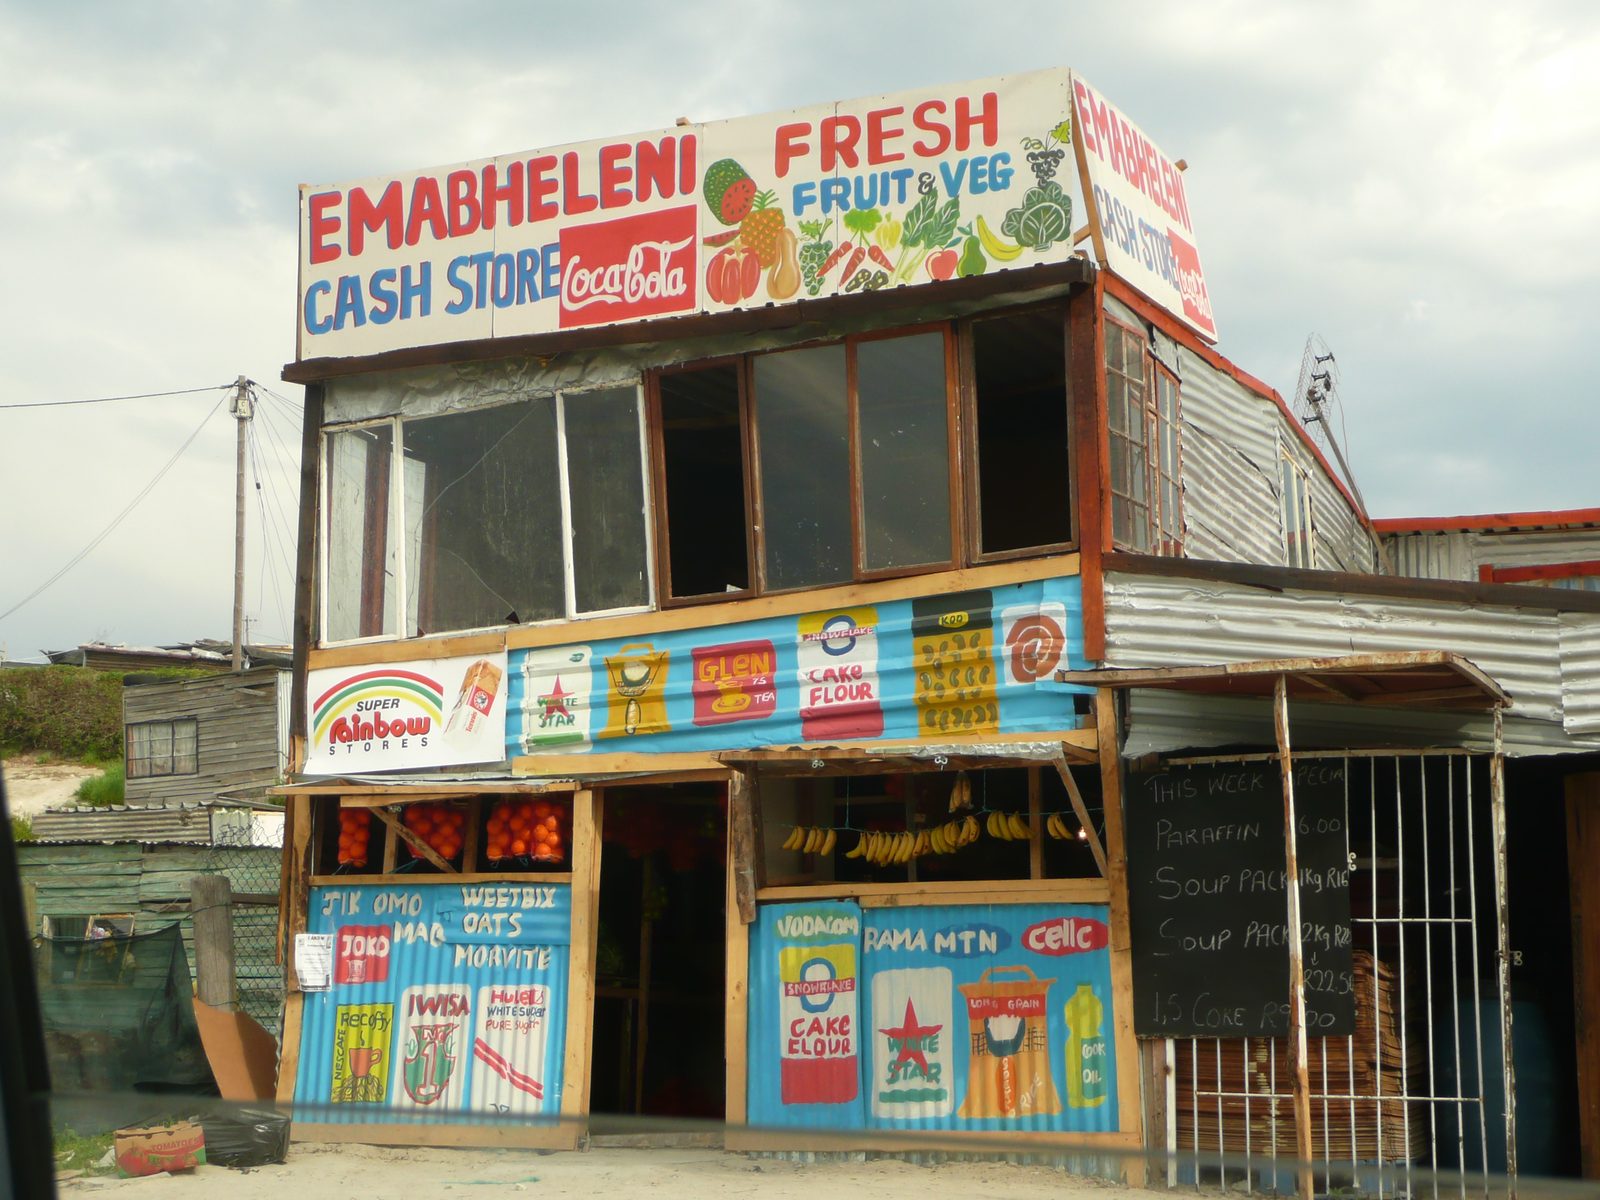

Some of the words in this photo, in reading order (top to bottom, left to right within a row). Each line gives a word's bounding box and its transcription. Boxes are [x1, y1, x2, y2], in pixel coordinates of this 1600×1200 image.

[775, 92, 998, 178] FRESH
[1074, 79, 1193, 234] EMABHELENI
[793, 168, 914, 216] FRUIT
[918, 171, 936, 195] &
[939, 152, 1015, 198] VEG
[309, 134, 697, 265] EMABHELENI
[1094, 184, 1141, 263] CASH
[1138, 217, 1181, 292] STORE
[304, 261, 431, 335] CASH
[445, 242, 560, 315] STORE
[804, 626, 874, 641] SNOWFLAKE
[356, 698, 400, 712] SUPER
[754, 692, 775, 704] TEA
[810, 682, 874, 706] FLOUR
[539, 713, 575, 728] STAR
[329, 737, 428, 756] STORES
[1144, 773, 1198, 804] THIS
[1208, 772, 1265, 796] WEEK
[1156, 818, 1261, 852] PARAFFIN
[1156, 866, 1231, 900] SOUP
[322, 891, 362, 917] JIK
[373, 892, 423, 917] OMO
[461, 887, 556, 908] WEETBIX
[393, 921, 447, 948] MAQ
[462, 912, 523, 938] OATS
[341, 935, 390, 958] JOKO
[864, 927, 927, 953] RAMA
[934, 931, 997, 954] MTN
[454, 944, 551, 970] MORVITE
[788, 979, 852, 996] SNOWFLAKE
[408, 994, 471, 1017] IWISA
[487, 1005, 518, 1018] WHITE
[971, 998, 998, 1008] LONG
[1008, 998, 1040, 1009] GRAIN
[486, 1019, 512, 1031] PURE
[334, 1029, 346, 1080] NESCAFE
[886, 1060, 942, 1084] STAR
[1083, 1069, 1102, 1084] OIL
